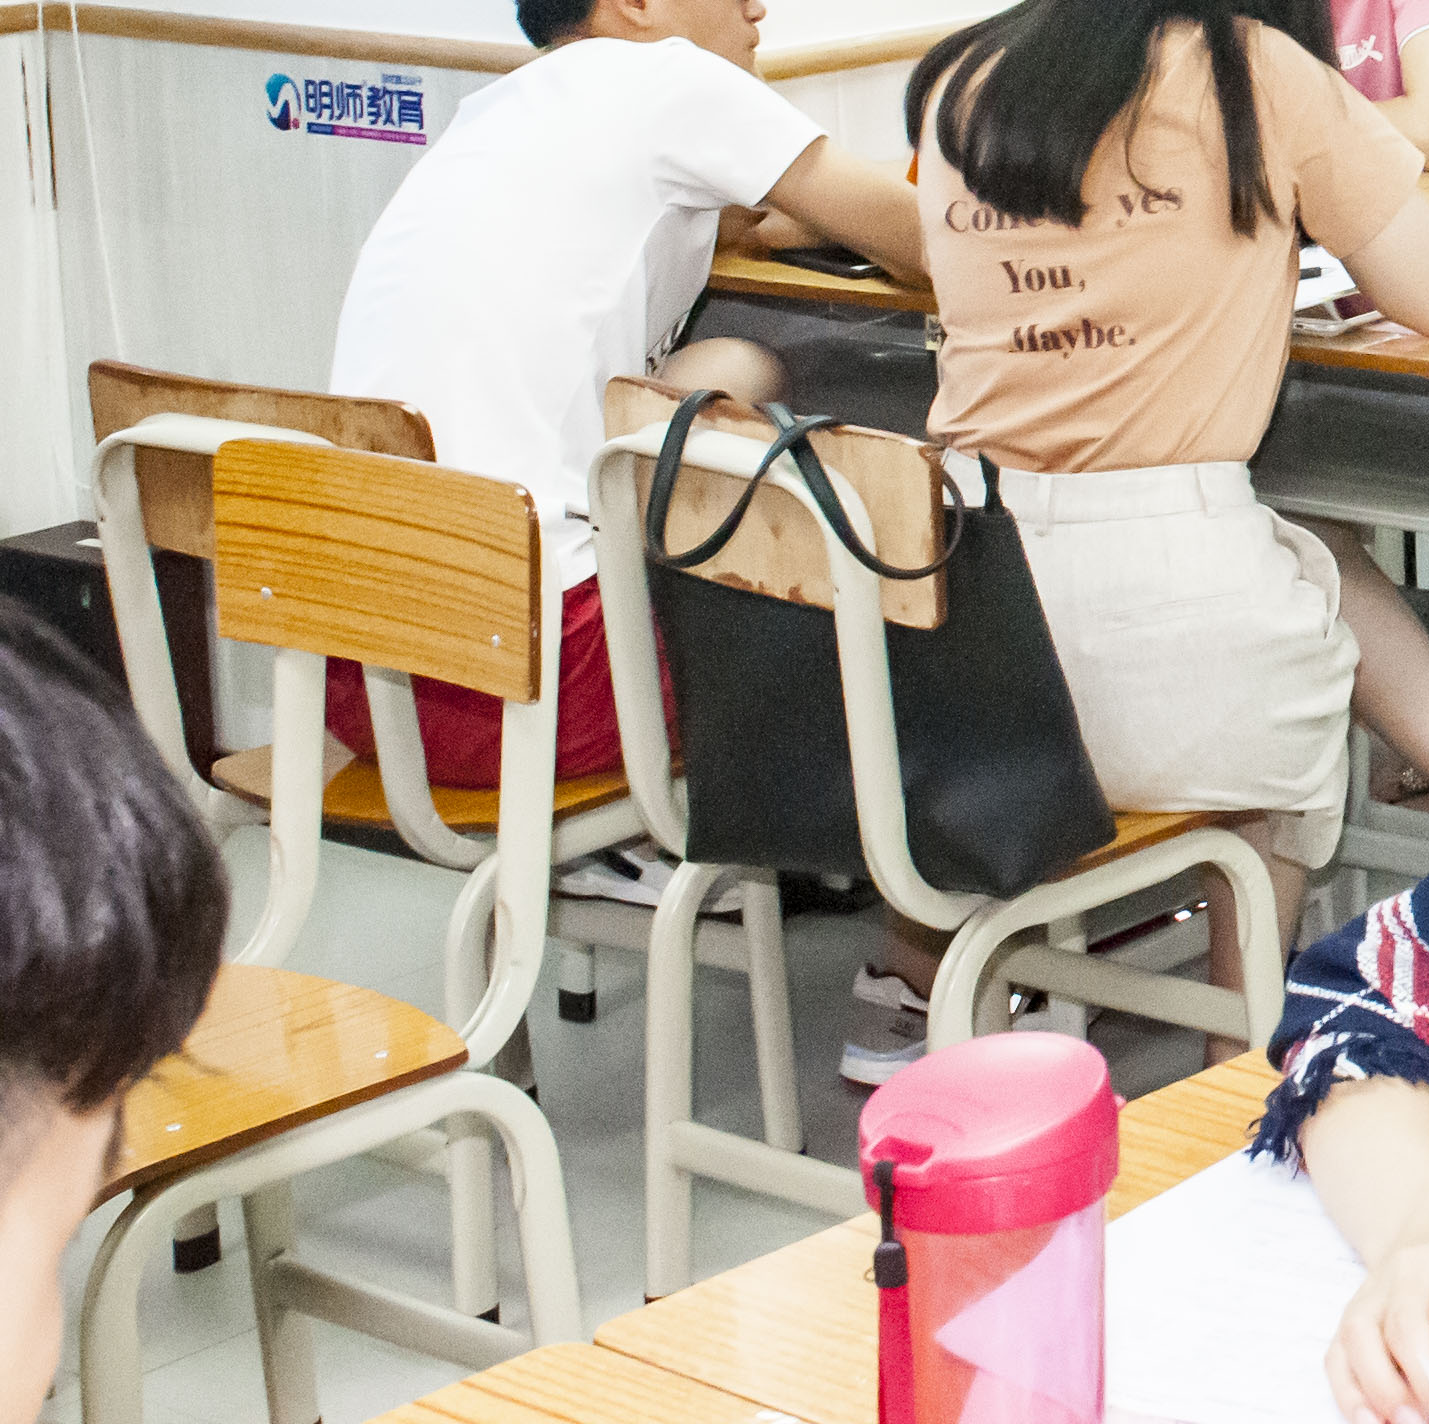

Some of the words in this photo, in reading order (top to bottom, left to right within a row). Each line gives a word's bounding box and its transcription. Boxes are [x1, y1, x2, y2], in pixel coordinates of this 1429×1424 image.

[303, 78, 425, 130] 明师教育
[999, 258, 1087, 294] You,
[1008, 317, 1138, 360] Maybe.
